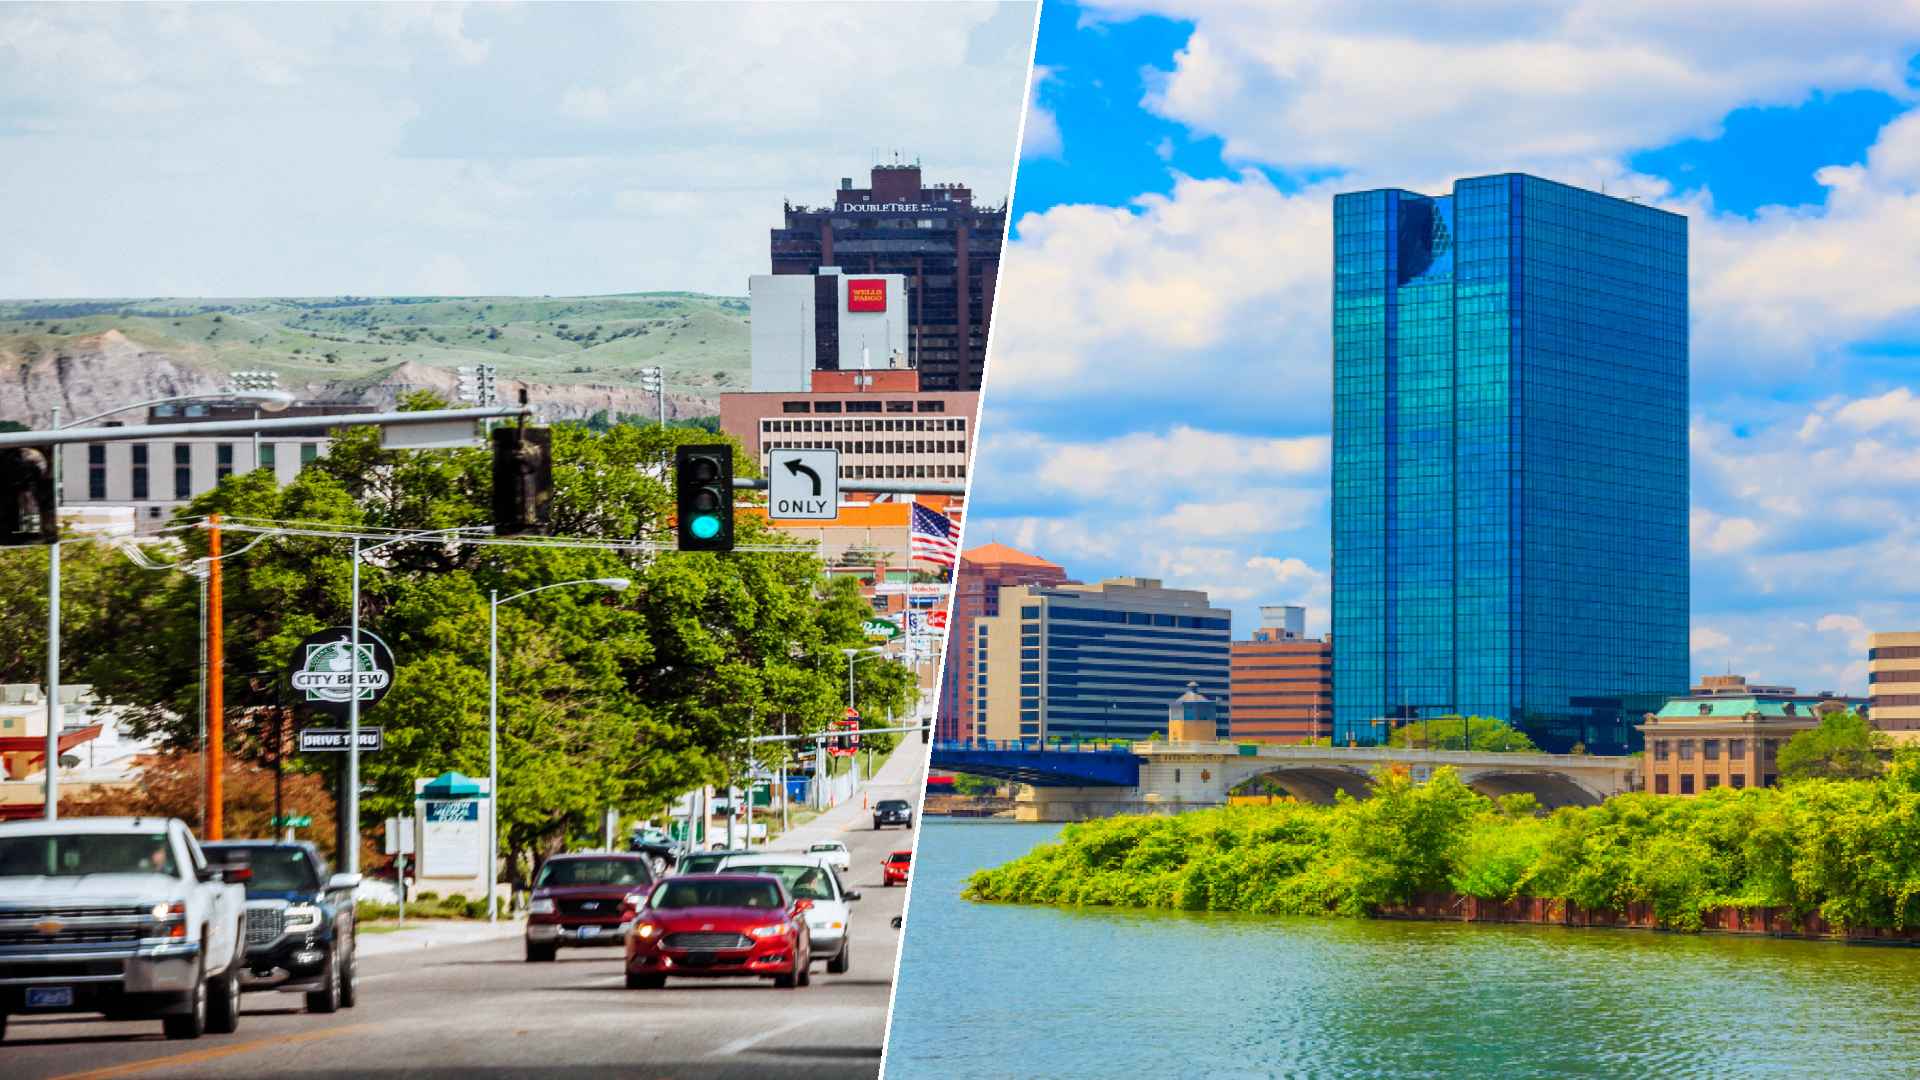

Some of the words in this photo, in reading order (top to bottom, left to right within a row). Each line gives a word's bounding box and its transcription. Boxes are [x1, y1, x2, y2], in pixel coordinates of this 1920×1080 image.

[778, 500, 827, 513] ONLY
[297, 674, 332, 685] CITY
[303, 735, 341, 746] DRIVE
[343, 735, 377, 746] TRU
